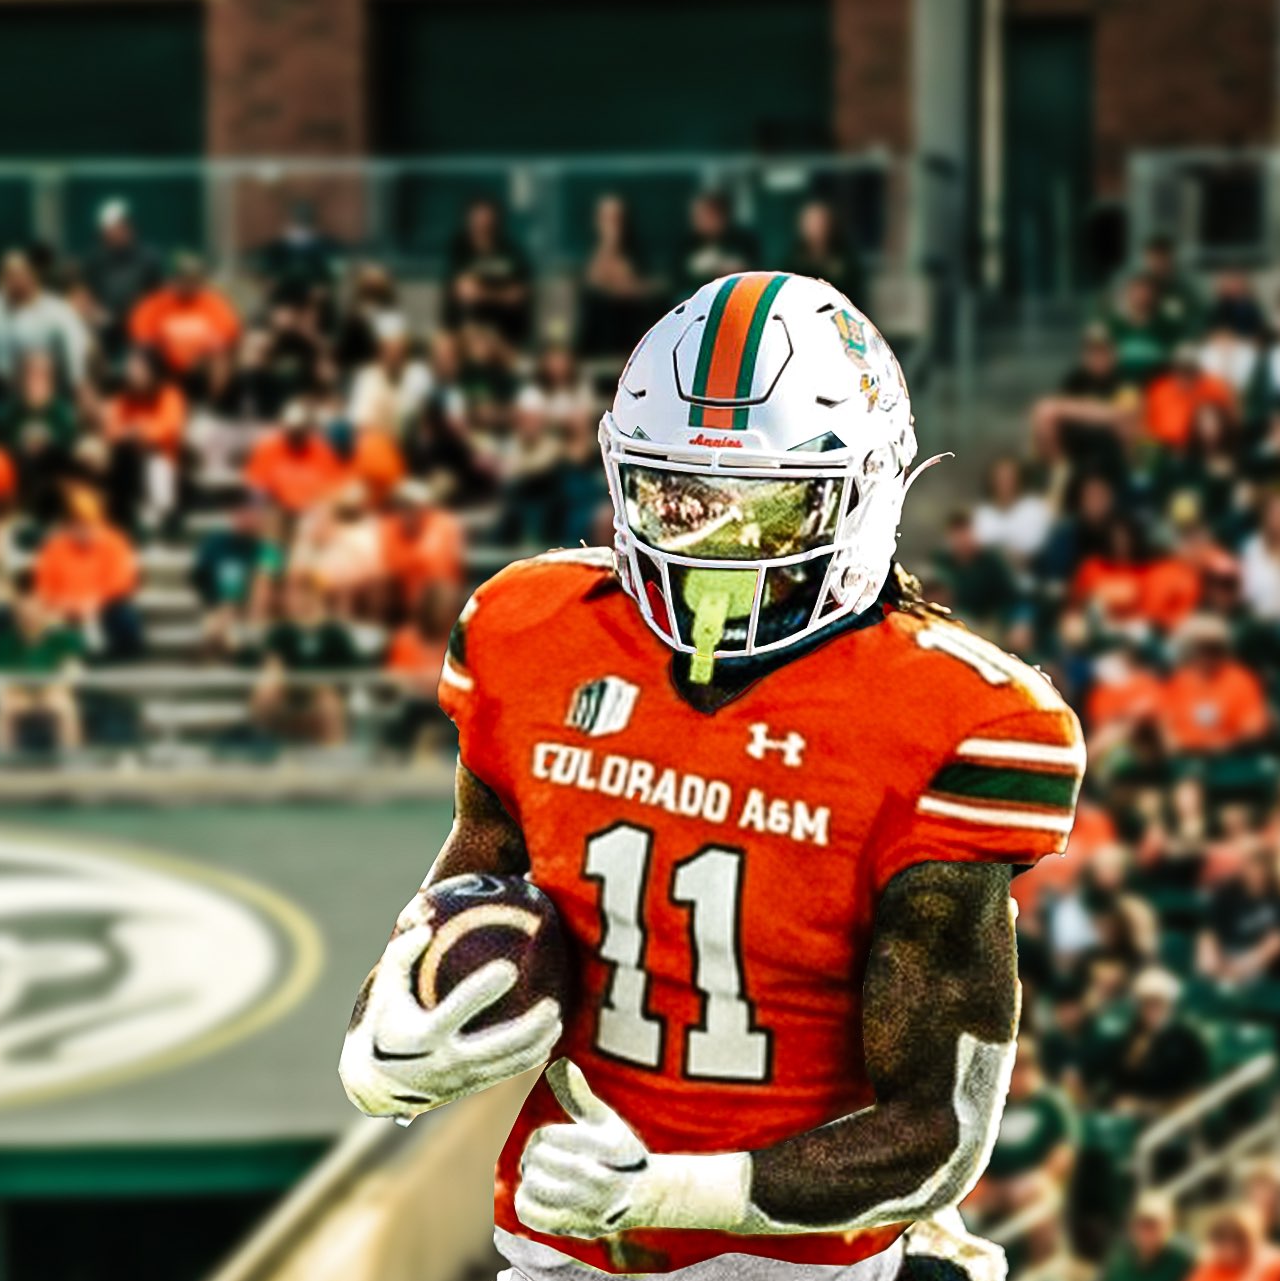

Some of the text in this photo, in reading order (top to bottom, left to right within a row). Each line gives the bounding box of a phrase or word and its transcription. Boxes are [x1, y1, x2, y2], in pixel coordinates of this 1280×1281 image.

[531, 741, 831, 846] COLORADO A&M
[581, 821, 772, 1083] 11
